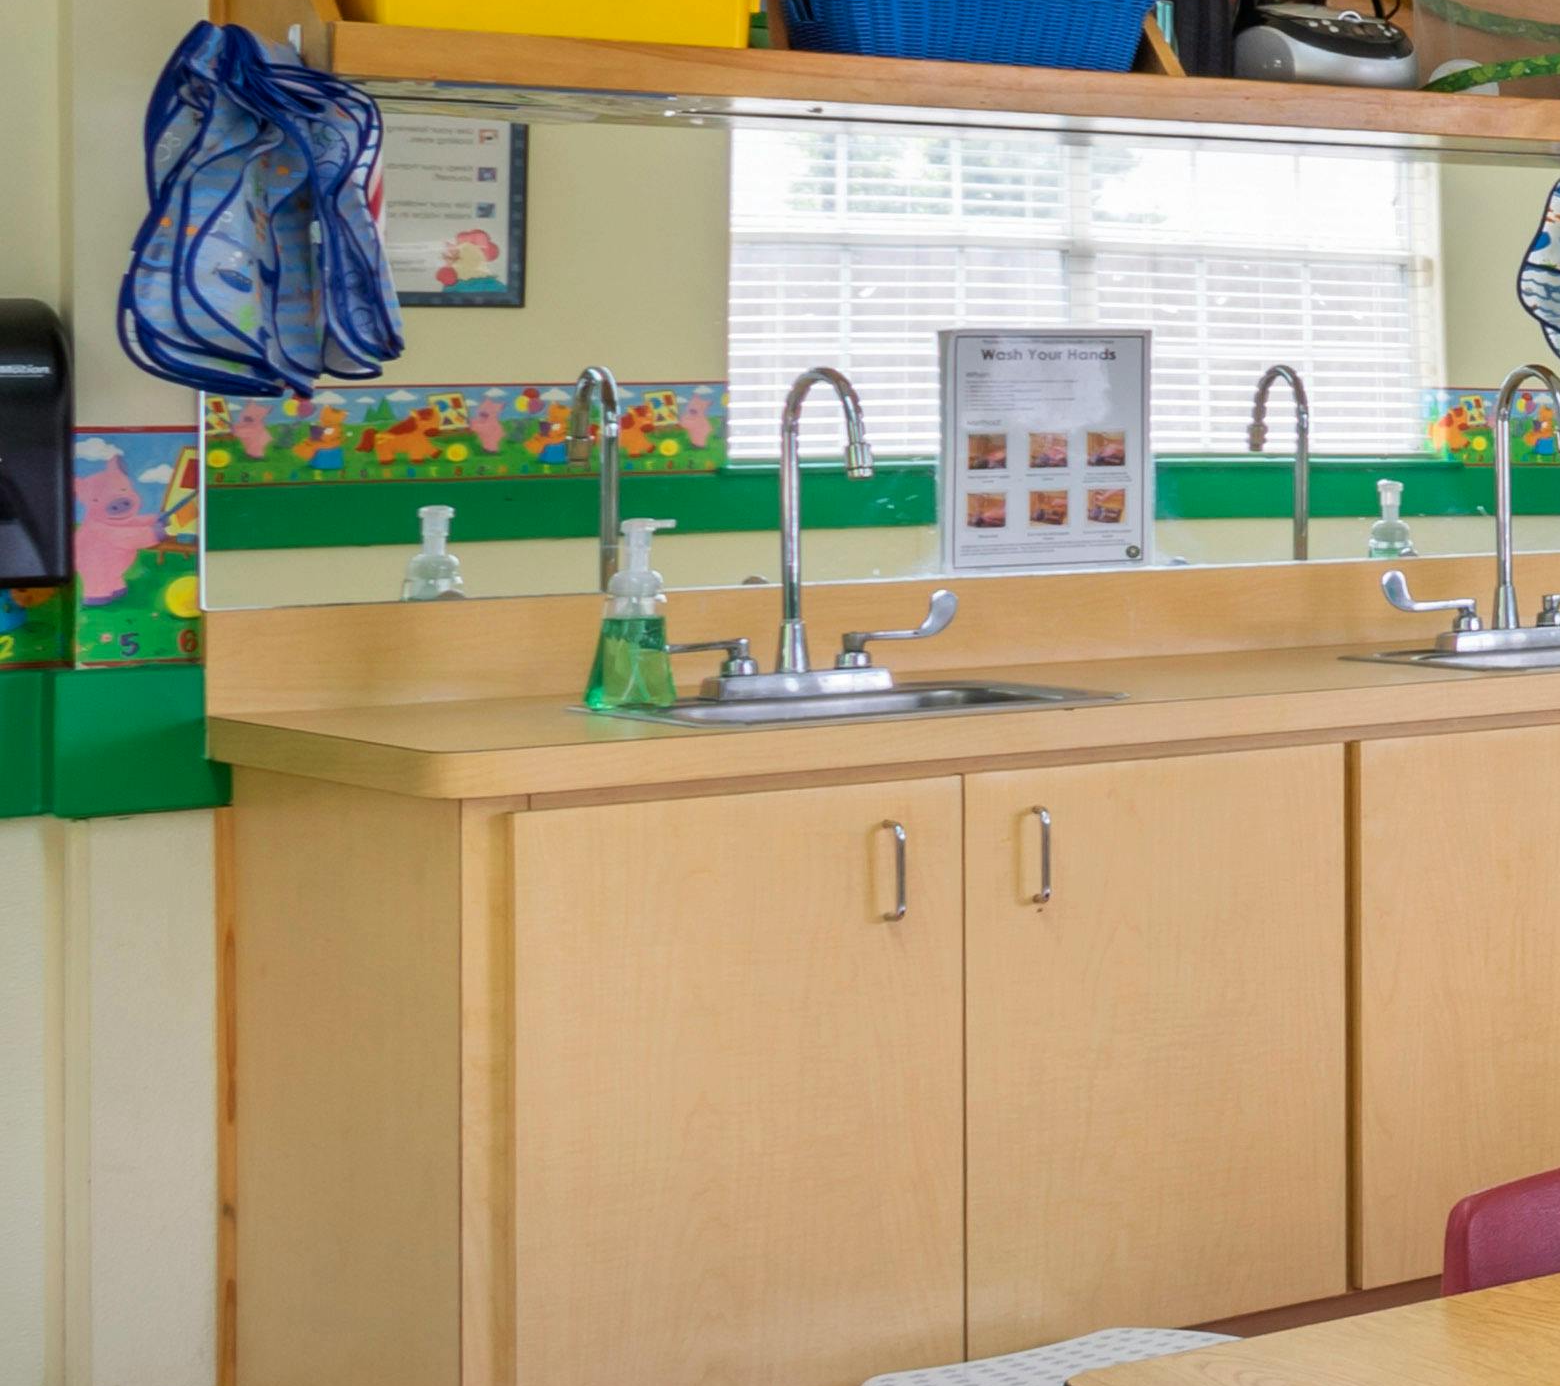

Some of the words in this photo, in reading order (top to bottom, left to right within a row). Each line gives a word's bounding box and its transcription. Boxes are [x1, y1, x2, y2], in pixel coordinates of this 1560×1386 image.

[981, 348, 1022, 361] Wash
[1027, 348, 1063, 361] Your
[1067, 348, 1117, 361] Hands
[118, 631, 140, 658] 5
[177, 628, 198, 655] 6
